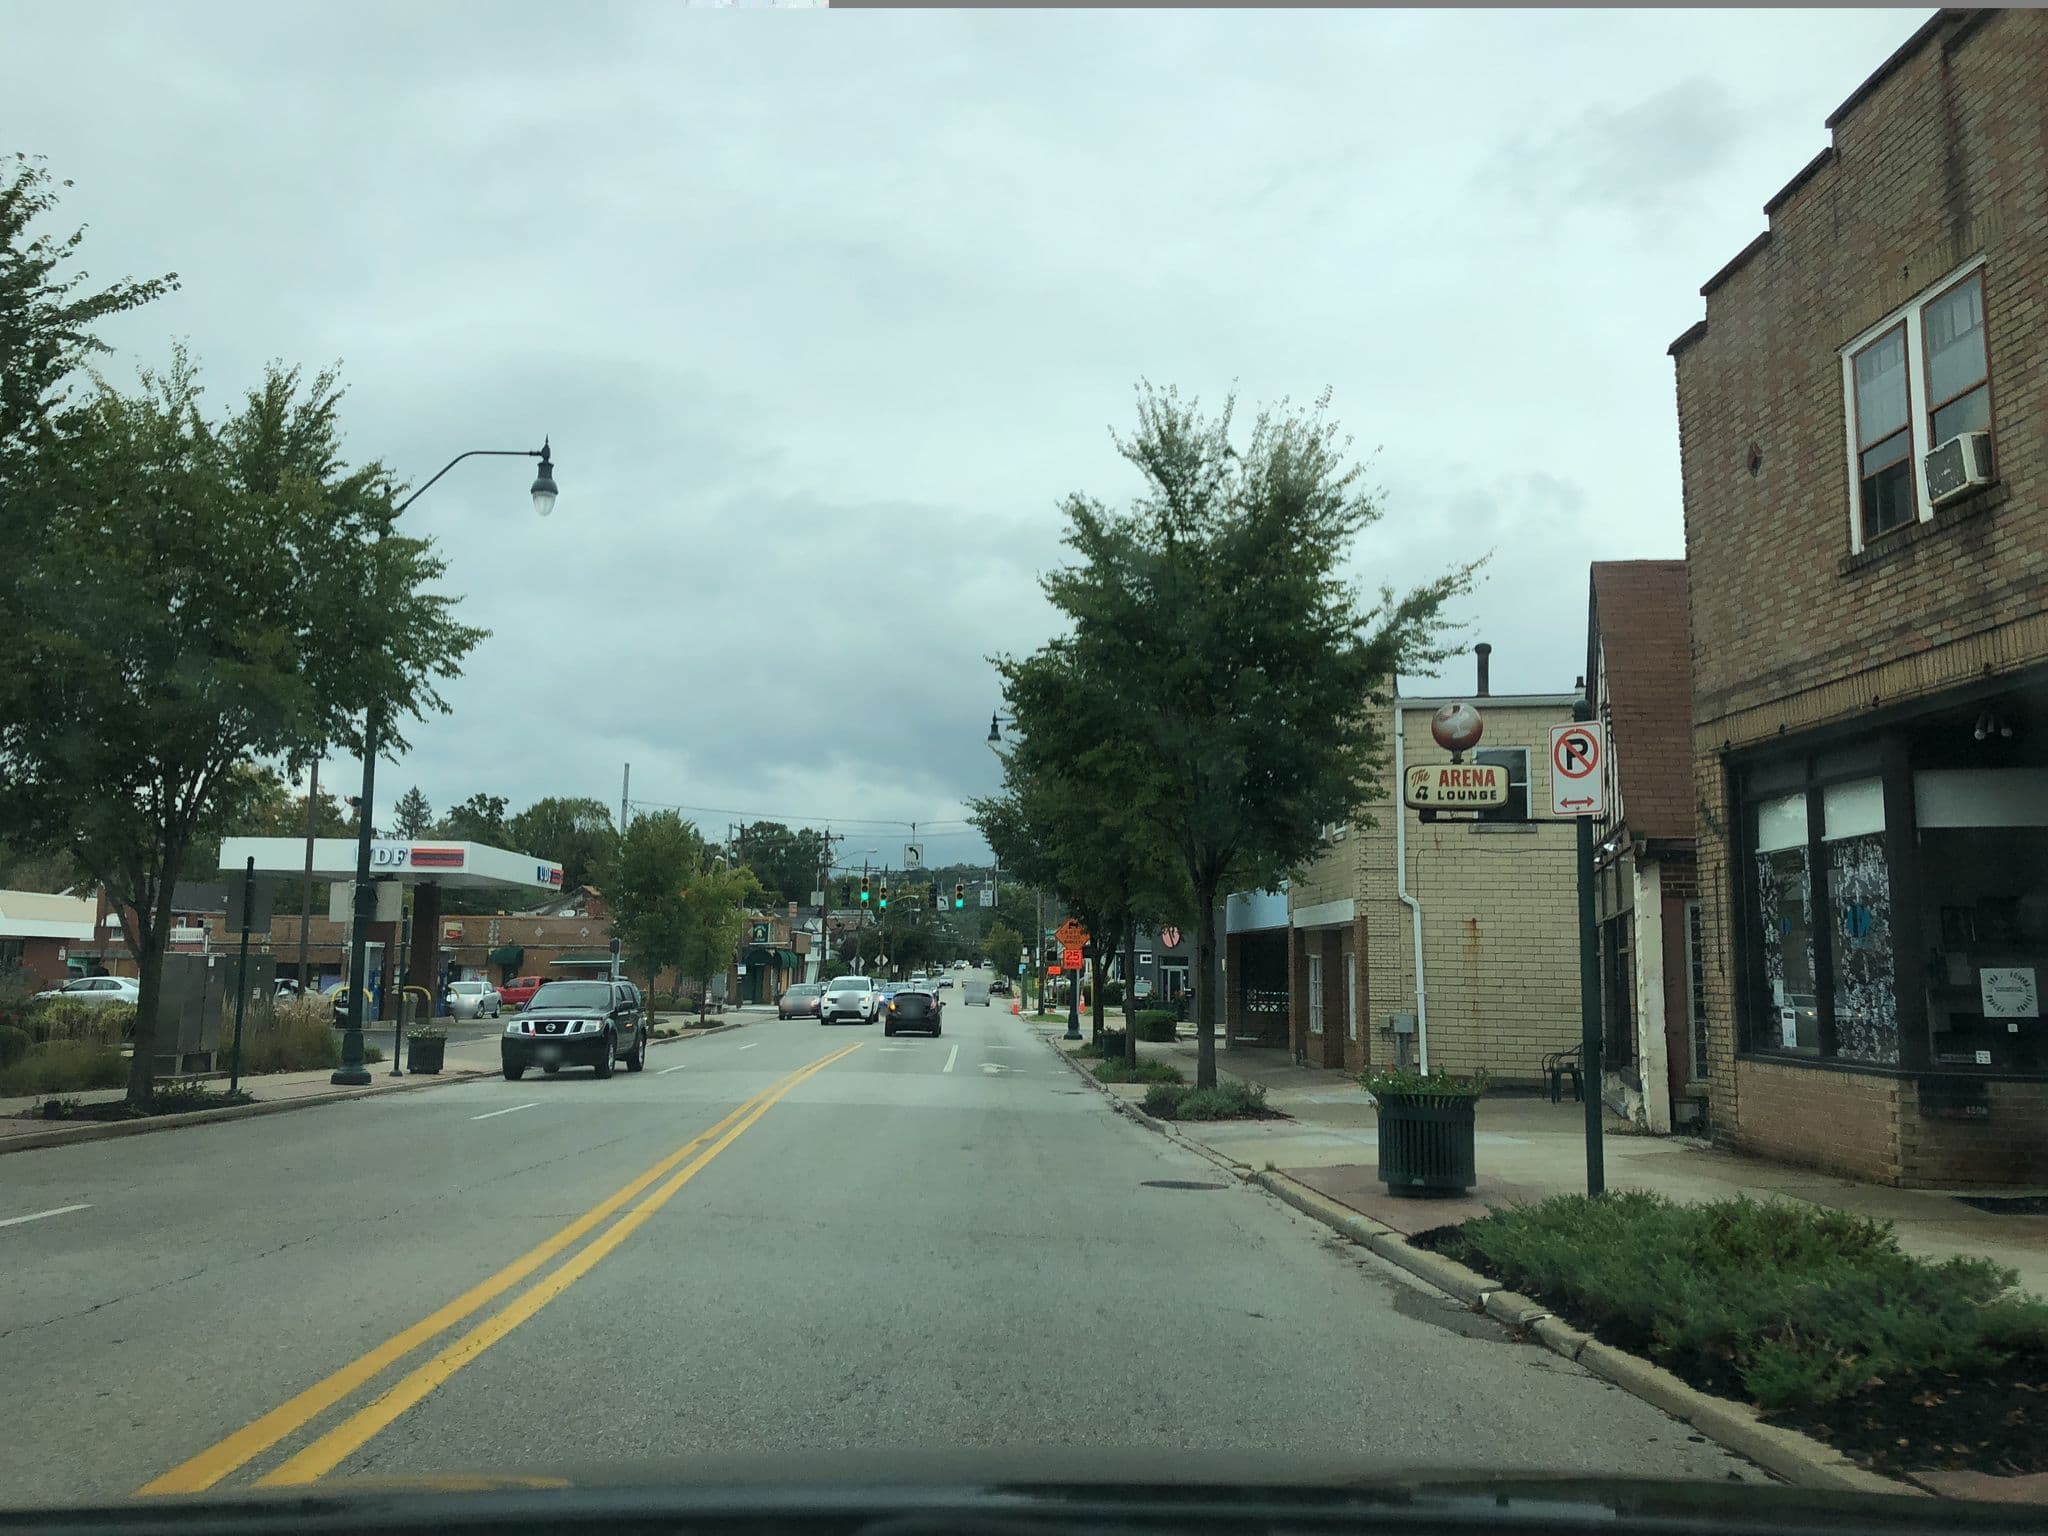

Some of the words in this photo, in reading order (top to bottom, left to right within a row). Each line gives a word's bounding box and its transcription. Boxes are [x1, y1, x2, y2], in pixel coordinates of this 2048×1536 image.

[1411, 768, 1430, 788] The
[1438, 769, 1496, 787] ARENA
[1437, 790, 1497, 800] LOUNGE
[1065, 951, 1080, 961] 25
